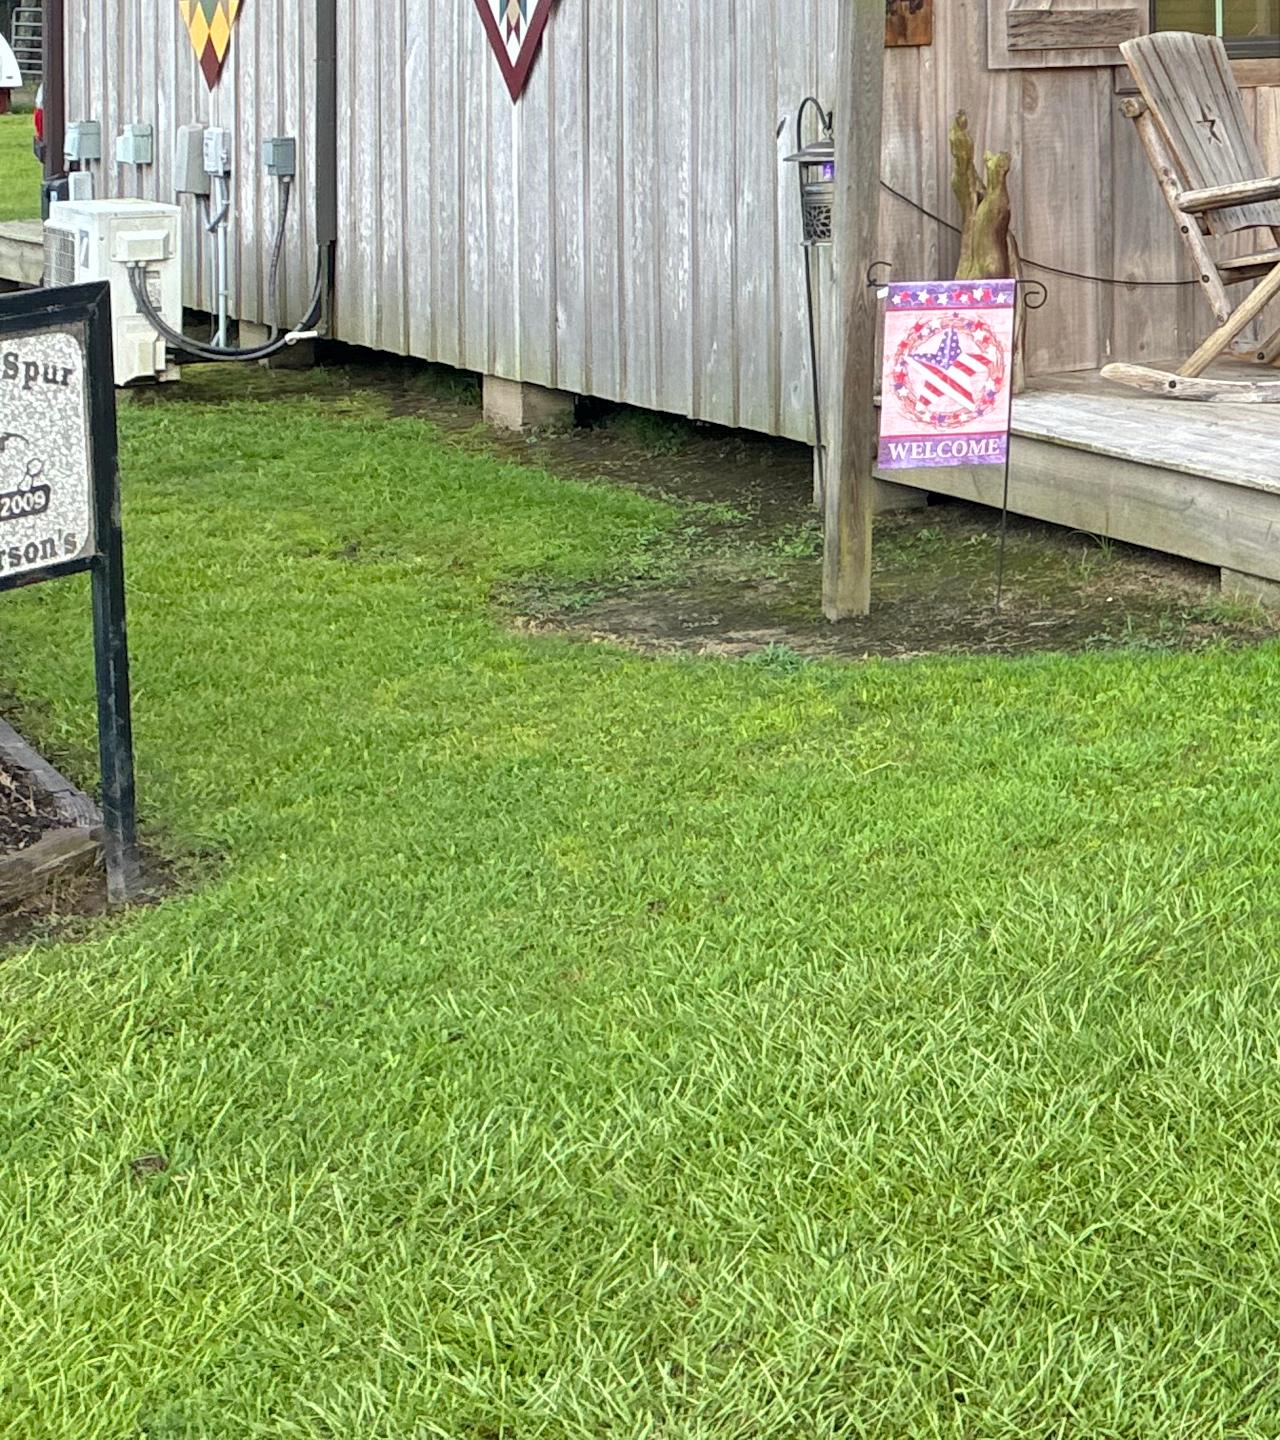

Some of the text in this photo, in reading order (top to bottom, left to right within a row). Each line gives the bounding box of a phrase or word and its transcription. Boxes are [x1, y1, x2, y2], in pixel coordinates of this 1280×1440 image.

[2, 352, 75, 390] Spur
[888, 438, 1000, 460] WELCOME
[0, 490, 46, 517] 2009
